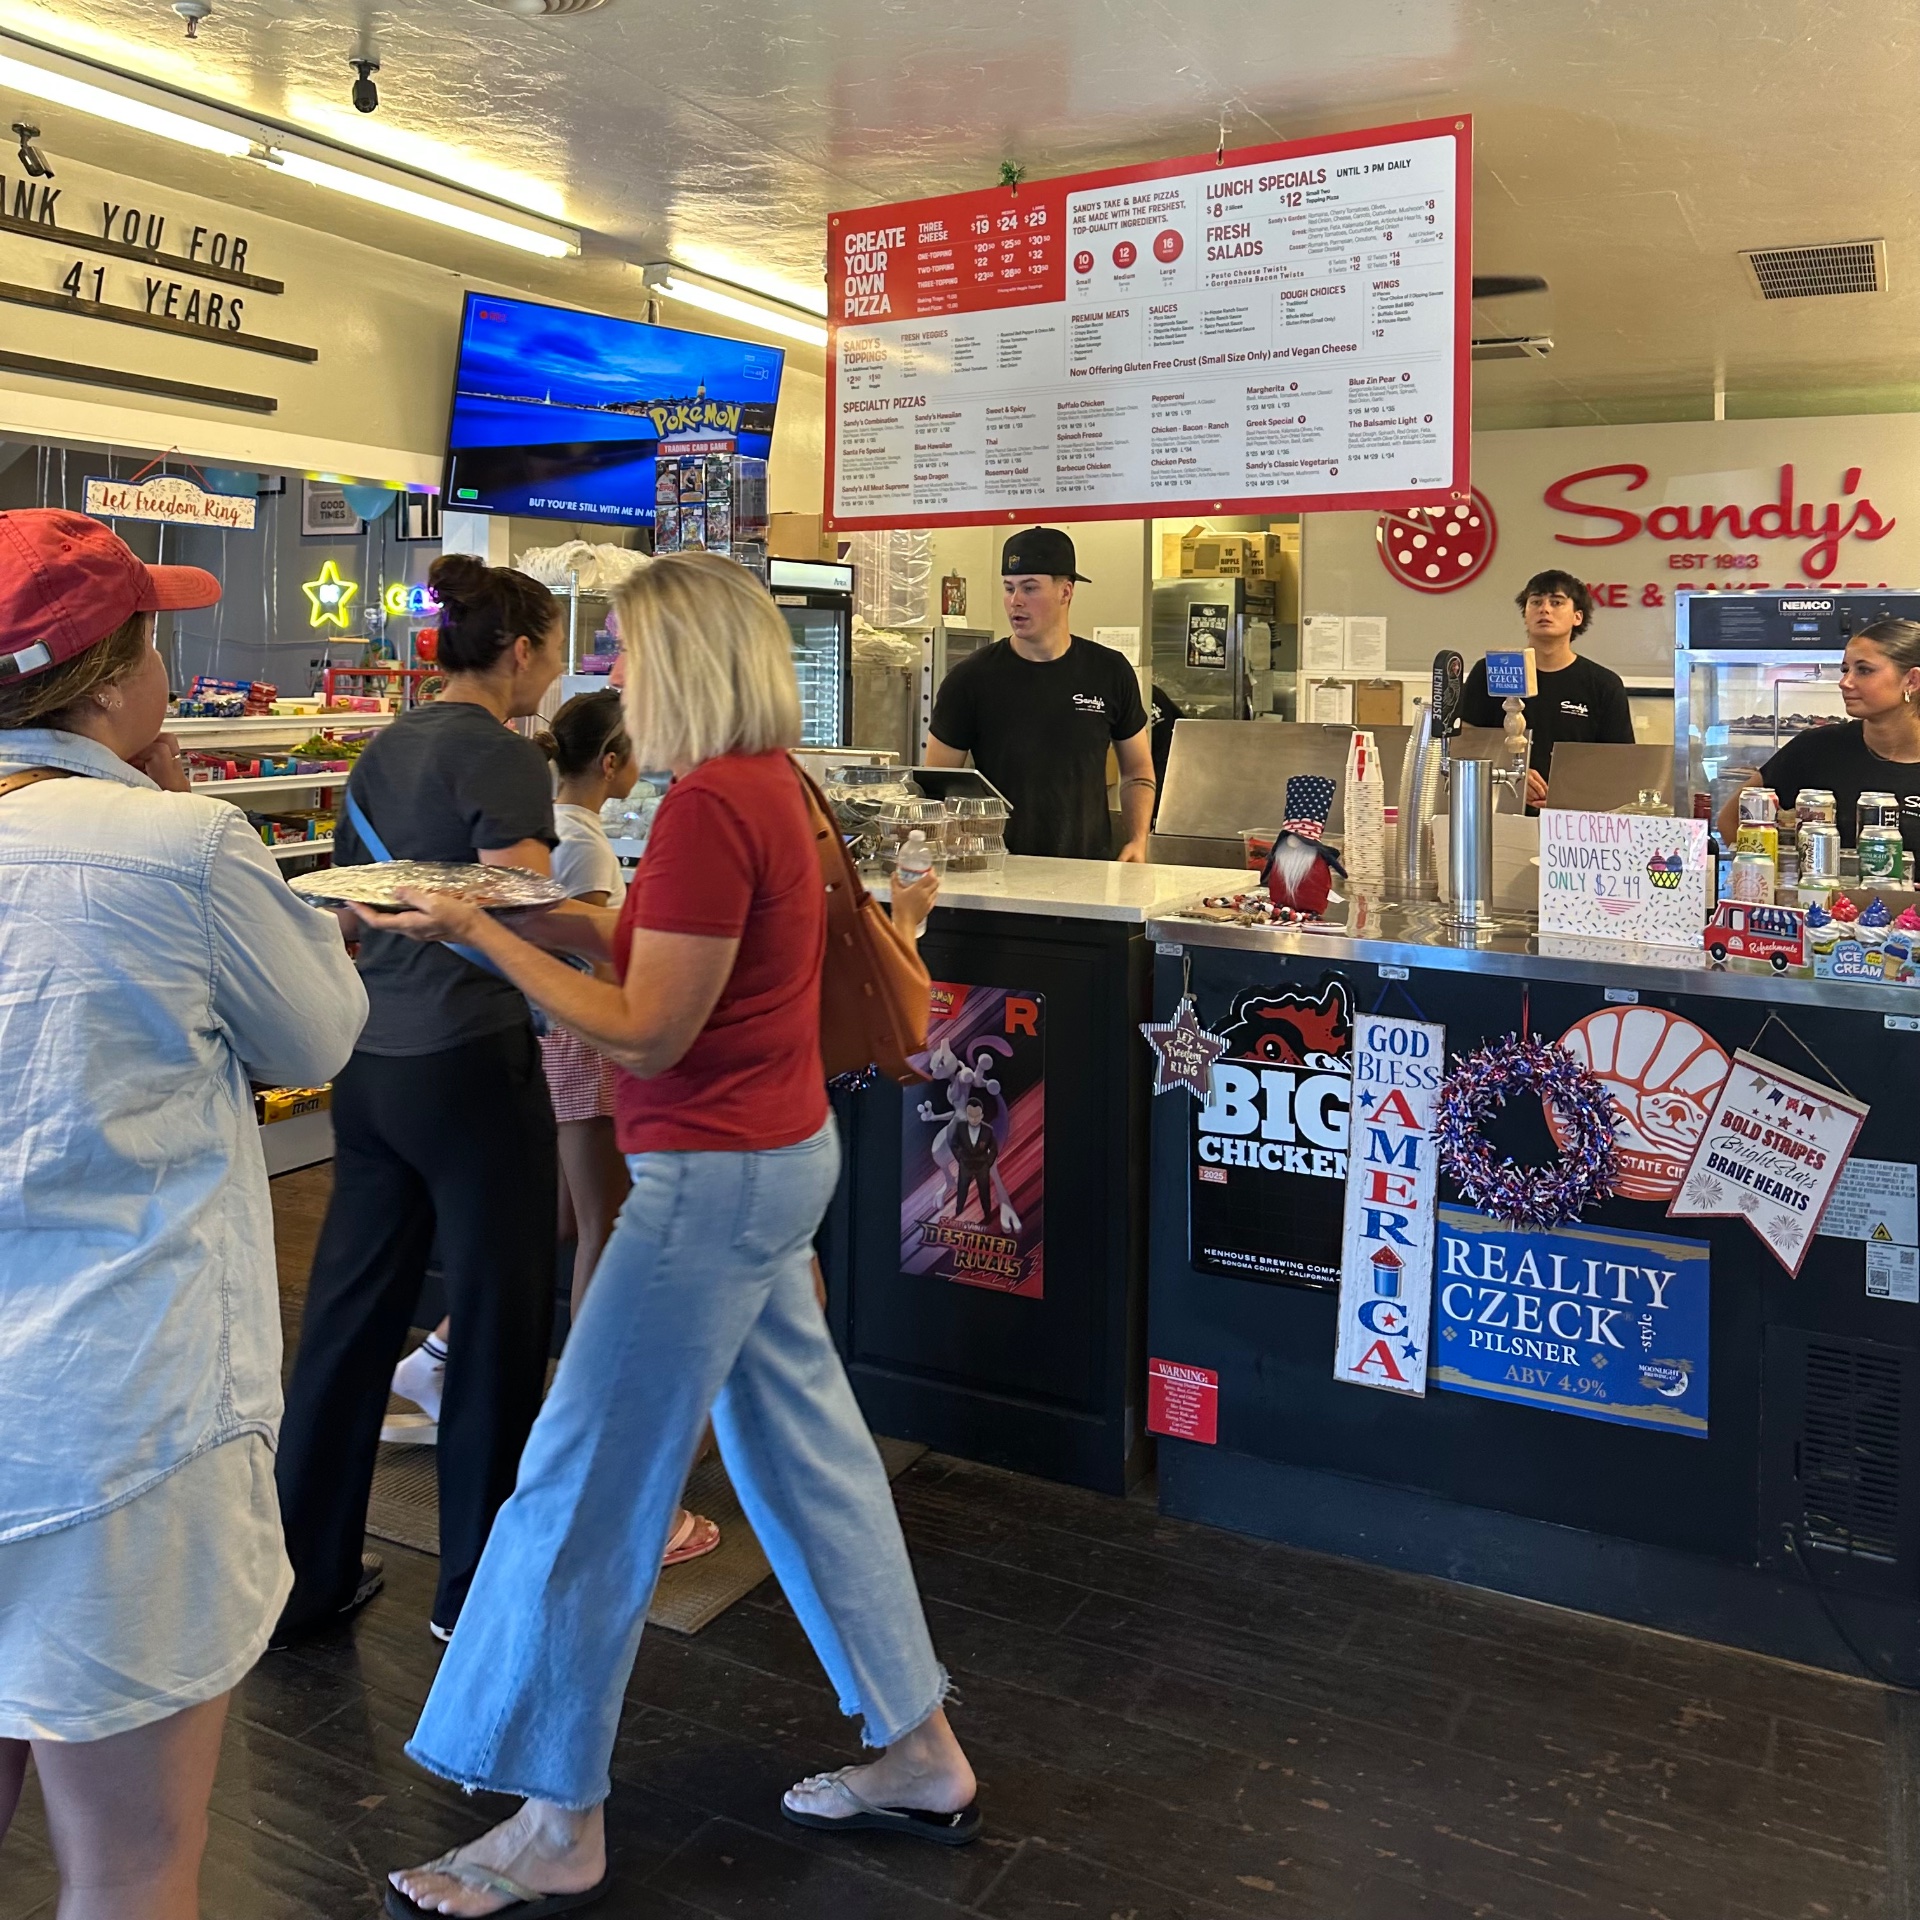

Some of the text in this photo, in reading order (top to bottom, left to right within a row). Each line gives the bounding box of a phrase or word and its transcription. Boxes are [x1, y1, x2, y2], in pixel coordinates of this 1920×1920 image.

[1206, 159, 1412, 200] LUNCH SPECIALS UNTIL 3 PM DAILY
[1073, 190, 1180, 214] SANDY'S TAKE & BAKE PIZZAS
[1207, 202, 1222, 218] $8
[1280, 192, 1302, 208] $12
[918, 211, 1047, 234] THREE $19 $24 $29
[1073, 201, 1186, 224] ARE MADE WITH THE FRESHEST,
[1073, 215, 1168, 235] TOP-QUALITY INGREDIENTS.
[1206, 223, 1250, 242] FRESH
[103, 201, 164, 251] YOU
[190, 226, 248, 273] FOR
[845, 227, 906, 254] CREATE
[918, 230, 948, 244] CHEESE
[1162, 238, 1173, 248] 16
[1078, 254, 1089, 264] 10
[1120, 248, 1130, 258] 12
[1207, 240, 1263, 262] SALADS
[845, 252, 887, 276] YOUR
[1211, 264, 1287, 280] Pesto Cheese Twists
[845, 274, 885, 297] OWN
[1255, 274, 1278, 282] Bacon
[1280, 271, 1304, 279] Twists
[1372, 280, 1400, 290] WINGS
[62, 261, 244, 332] 41 YEARS
[1280, 289, 1308, 300] DOUGH
[845, 294, 892, 318] PIZZA
[1149, 304, 1178, 314] SAUCES
[1072, 310, 1130, 323] PREMIUM MEATS
[901, 330, 948, 342] FRESH VEGGIES
[844, 350, 887, 365] TOPPINGS
[1070, 342, 1357, 377] Now Offering Gluten Free Crust (Small Size Only) and Vegan Cheese
[1247, 384, 1285, 394] Margherita
[1349, 378, 1365, 386] Blue
[1379, 376, 1396, 384] Pear
[844, 396, 926, 413] SPECIALTY PIZZAS
[1246, 417, 1294, 427] Greek Special
[1349, 416, 1417, 428] The Balsamic Light
[664, 442, 728, 453] TRADING CARD GAME
[102, 487, 242, 526] Let Freedom Ring
[320, 500, 345, 510] GOOD
[320, 510, 346, 520] TIMES
[529, 498, 546, 508] BUT
[547, 500, 577, 511] YOU'RE
[579, 502, 598, 513] STILL
[600, 504, 619, 515] WITH
[620, 507, 633, 516] ME
[635, 508, 644, 516] IN
[1544, 464, 1895, 579] Sandy's
[1669, 554, 1759, 569] EST 1983
[1586, 583, 1666, 608] KE &
[1782, 601, 1831, 610] NEMCO
[1488, 666, 1524, 675] REALITY
[1489, 674, 1518, 683] CZECK
[1432, 668, 1443, 720] HENHOUSE
[1547, 814, 1632, 844] ICE CREAM
[1548, 844, 1622, 872] SUNDAES
[1548, 870, 1640, 899] ONLY $2.49
[1749, 942, 1797, 955] Refreshments
[1839, 951, 1862, 962] ICE
[1834, 963, 1882, 978] CREAM
[1177, 1030, 1194, 1044] LET
[1368, 1024, 1430, 1058] GOD
[1170, 1061, 1198, 1076] RING
[1357, 1052, 1440, 1090] BLESS
[1198, 1065, 1350, 1150] BIG
[1720, 1110, 1827, 1170] BOLD STRIPES
[1710, 1133, 1818, 1190] Bright Stars
[1204, 1171, 1224, 1180] 2025
[1706, 1152, 1751, 1185] BRAVE
[1752, 1173, 1810, 1211] HEARTS
[922, 1224, 1017, 1256] DESTINED
[1348, 1089, 1425, 1383] AMERCA
[954, 1247, 1023, 1278] RIVALS
[1204, 1248, 1342, 1275] HENHOUSE BREWING COMPA
[1222, 1260, 1252, 1269] SONOMA
[1289, 1270, 1335, 1282] CALIFORNIA
[1442, 1237, 1676, 1309] REALITY
[1442, 1283, 1656, 1353] CZECK -style
[1469, 1329, 1580, 1366] PILSNER
[1159, 1363, 1208, 1384] WARNING:
[1639, 1364, 1679, 1376] MOONLIGHT
[1504, 1364, 1606, 1398] ABV 4.9%
